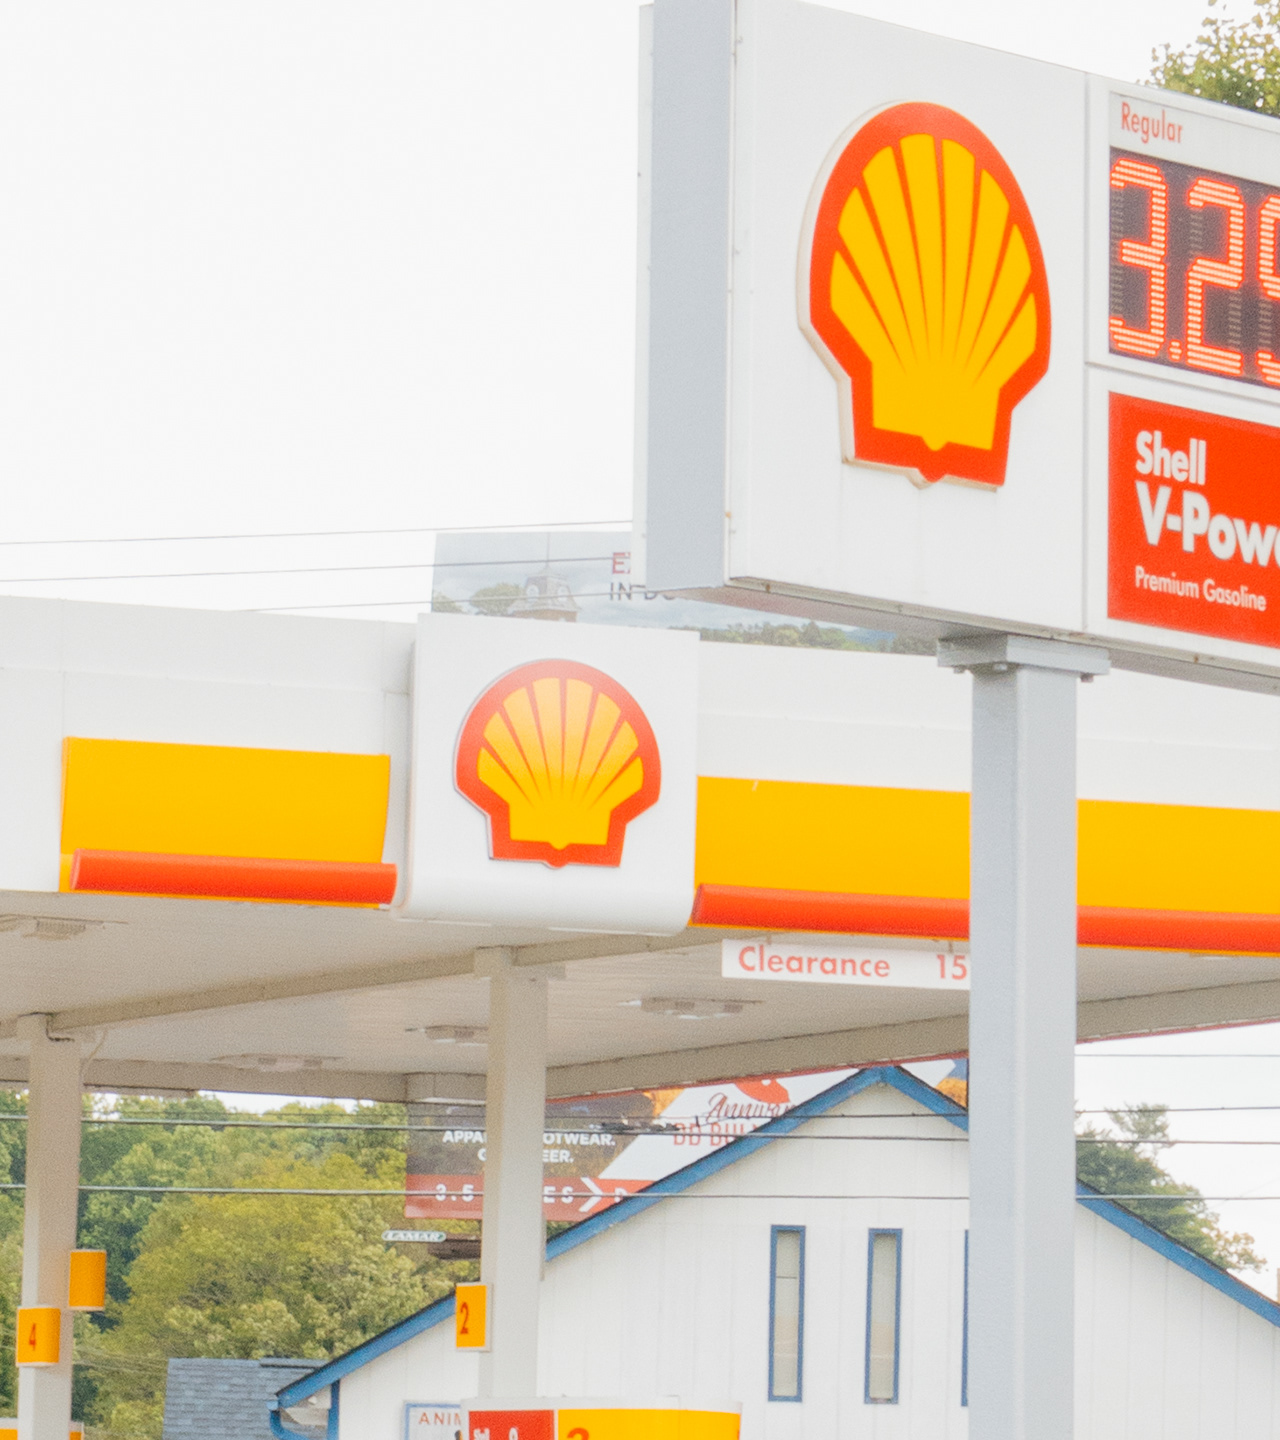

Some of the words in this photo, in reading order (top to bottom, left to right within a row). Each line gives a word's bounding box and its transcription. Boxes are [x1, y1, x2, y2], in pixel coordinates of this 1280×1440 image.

[1121, 101, 1183, 145] Regular
[1135, 430, 1207, 486] Shell
[1135, 565, 1200, 599] Premium
[1203, 578, 1267, 612] Gasoline
[738, 945, 891, 978] Clearance
[543, 1133, 616, 1146] OTWEAR.
[434, 1183, 475, 1202] 3.5
[460, 1301, 469, 1335] 2
